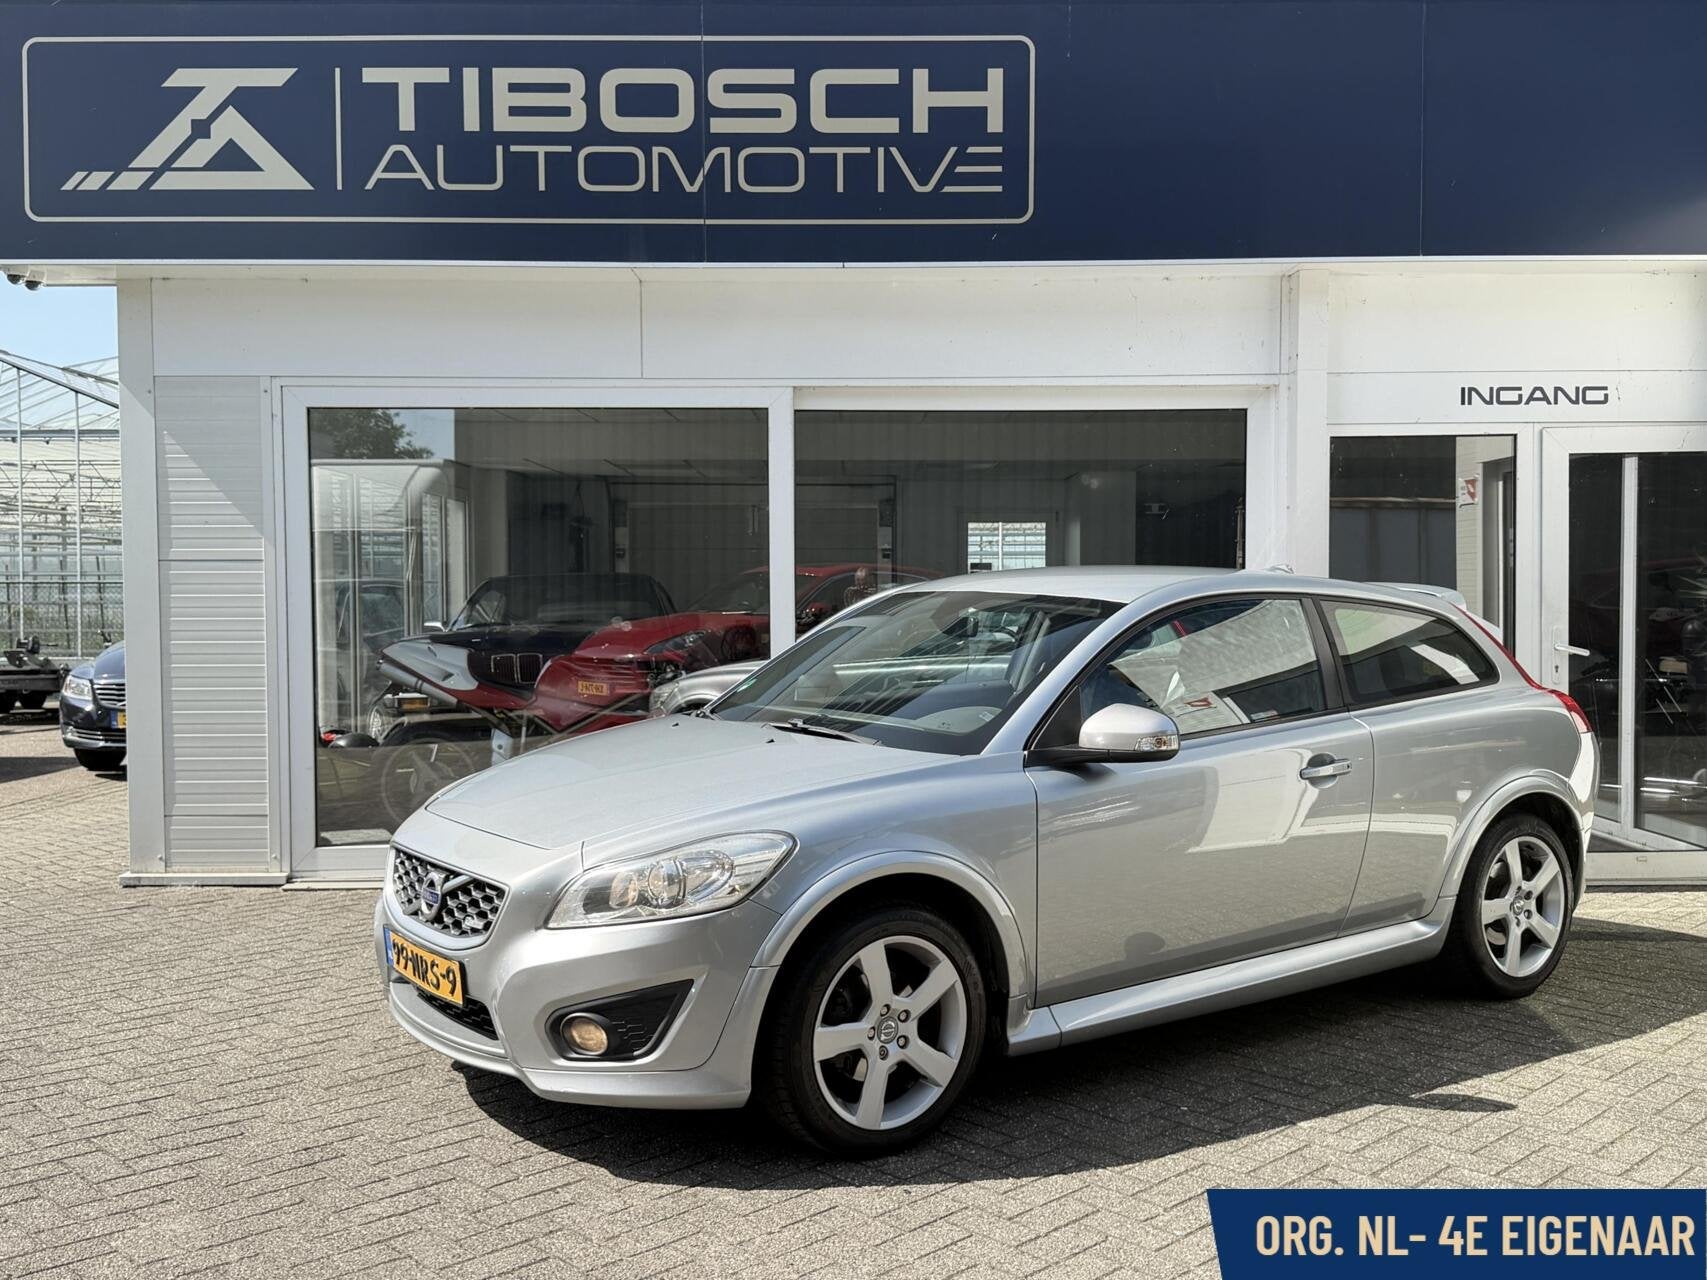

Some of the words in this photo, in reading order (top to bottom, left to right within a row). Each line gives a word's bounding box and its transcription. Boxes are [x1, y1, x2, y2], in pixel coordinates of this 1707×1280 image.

[362, 67, 1004, 134] TIBOSCH
[364, 145, 1004, 194] AUTOMOTIVE
[1460, 386, 1609, 406] INGANG
[392, 938, 457, 997] 99-NRS-9
